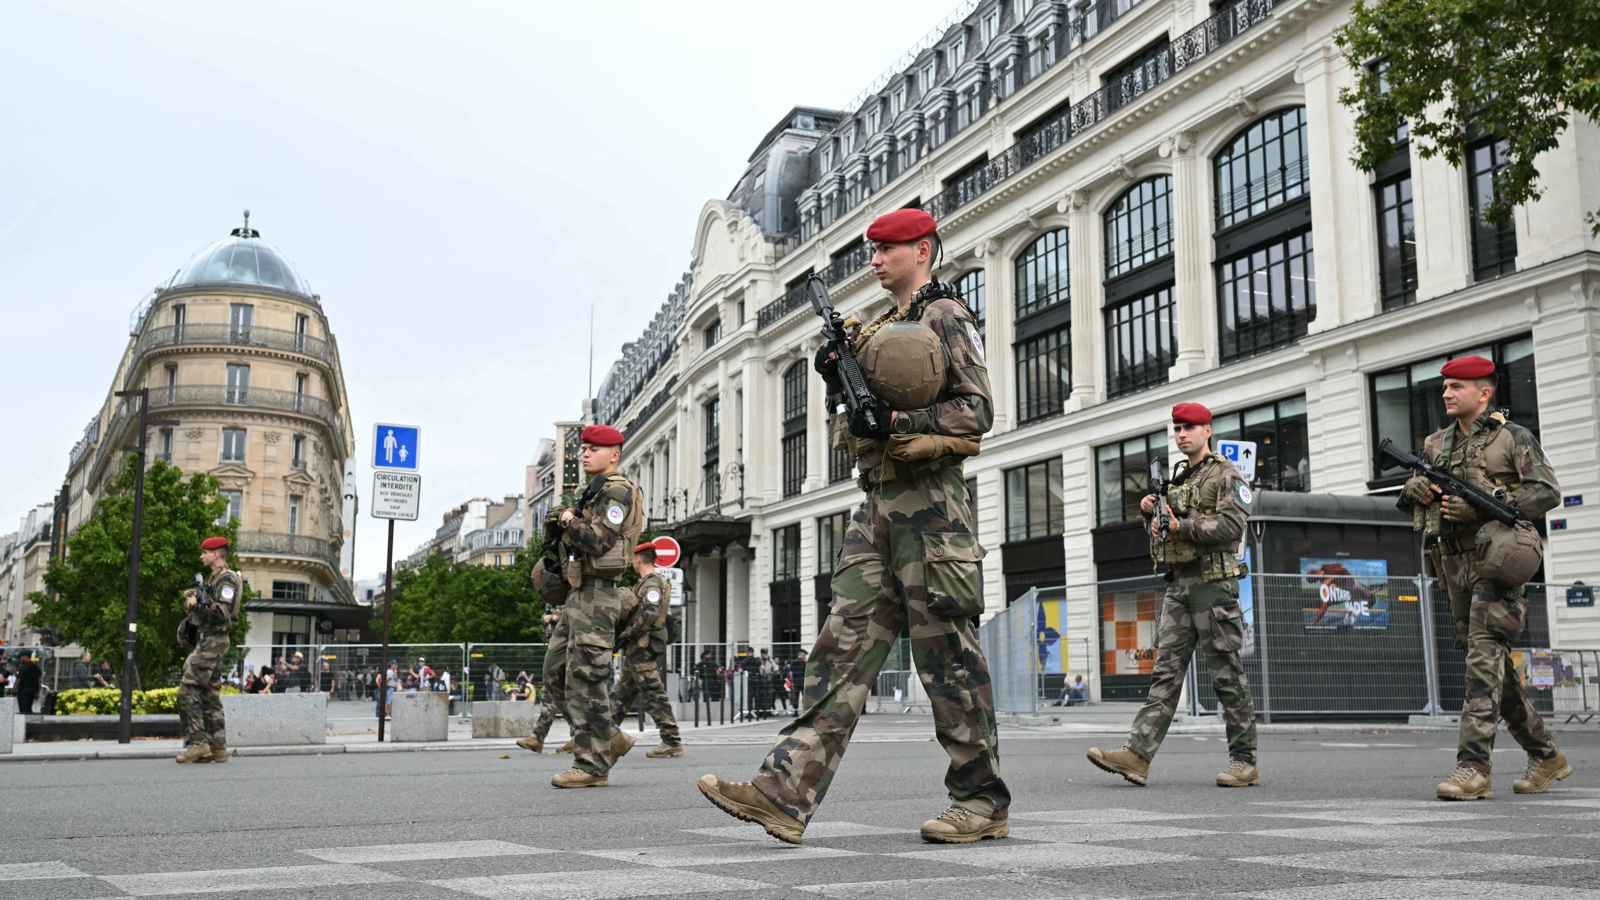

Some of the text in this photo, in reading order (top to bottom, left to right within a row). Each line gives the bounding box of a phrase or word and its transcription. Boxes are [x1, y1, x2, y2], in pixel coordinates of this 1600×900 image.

[1225, 446, 1234, 460] P
[376, 473, 418, 483] CIRCULATION
[380, 482, 413, 491] INTERDITE
